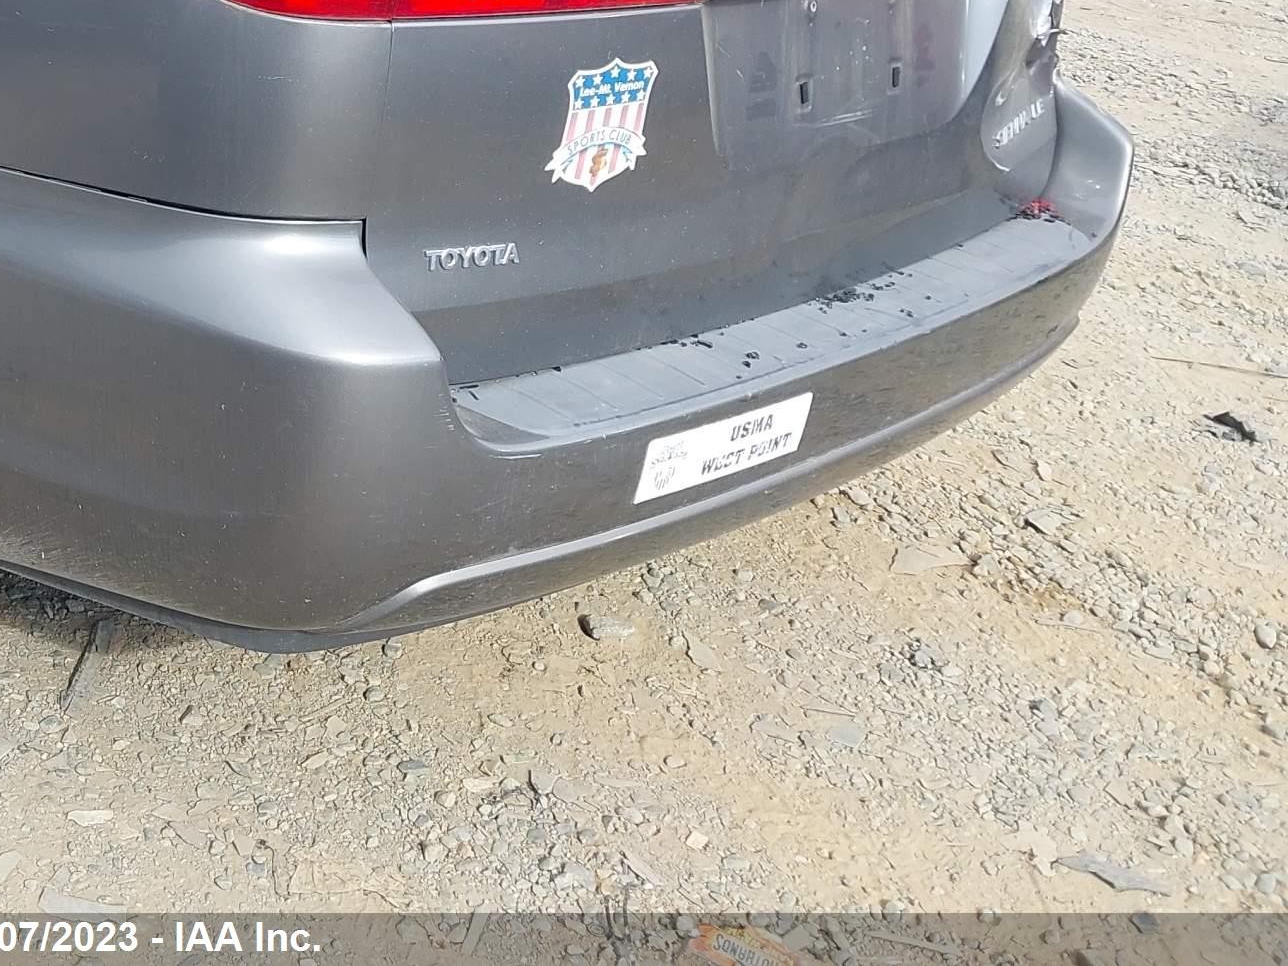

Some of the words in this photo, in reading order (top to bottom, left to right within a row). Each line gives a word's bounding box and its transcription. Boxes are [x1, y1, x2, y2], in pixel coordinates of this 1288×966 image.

[614, 81, 644, 93] Vernon
[567, 129, 605, 155] SPORTS
[608, 129, 632, 145] CLUB
[422, 242, 520, 272] TOYOTA
[730, 414, 773, 442] USMA
[747, 432, 793, 461] POINT
